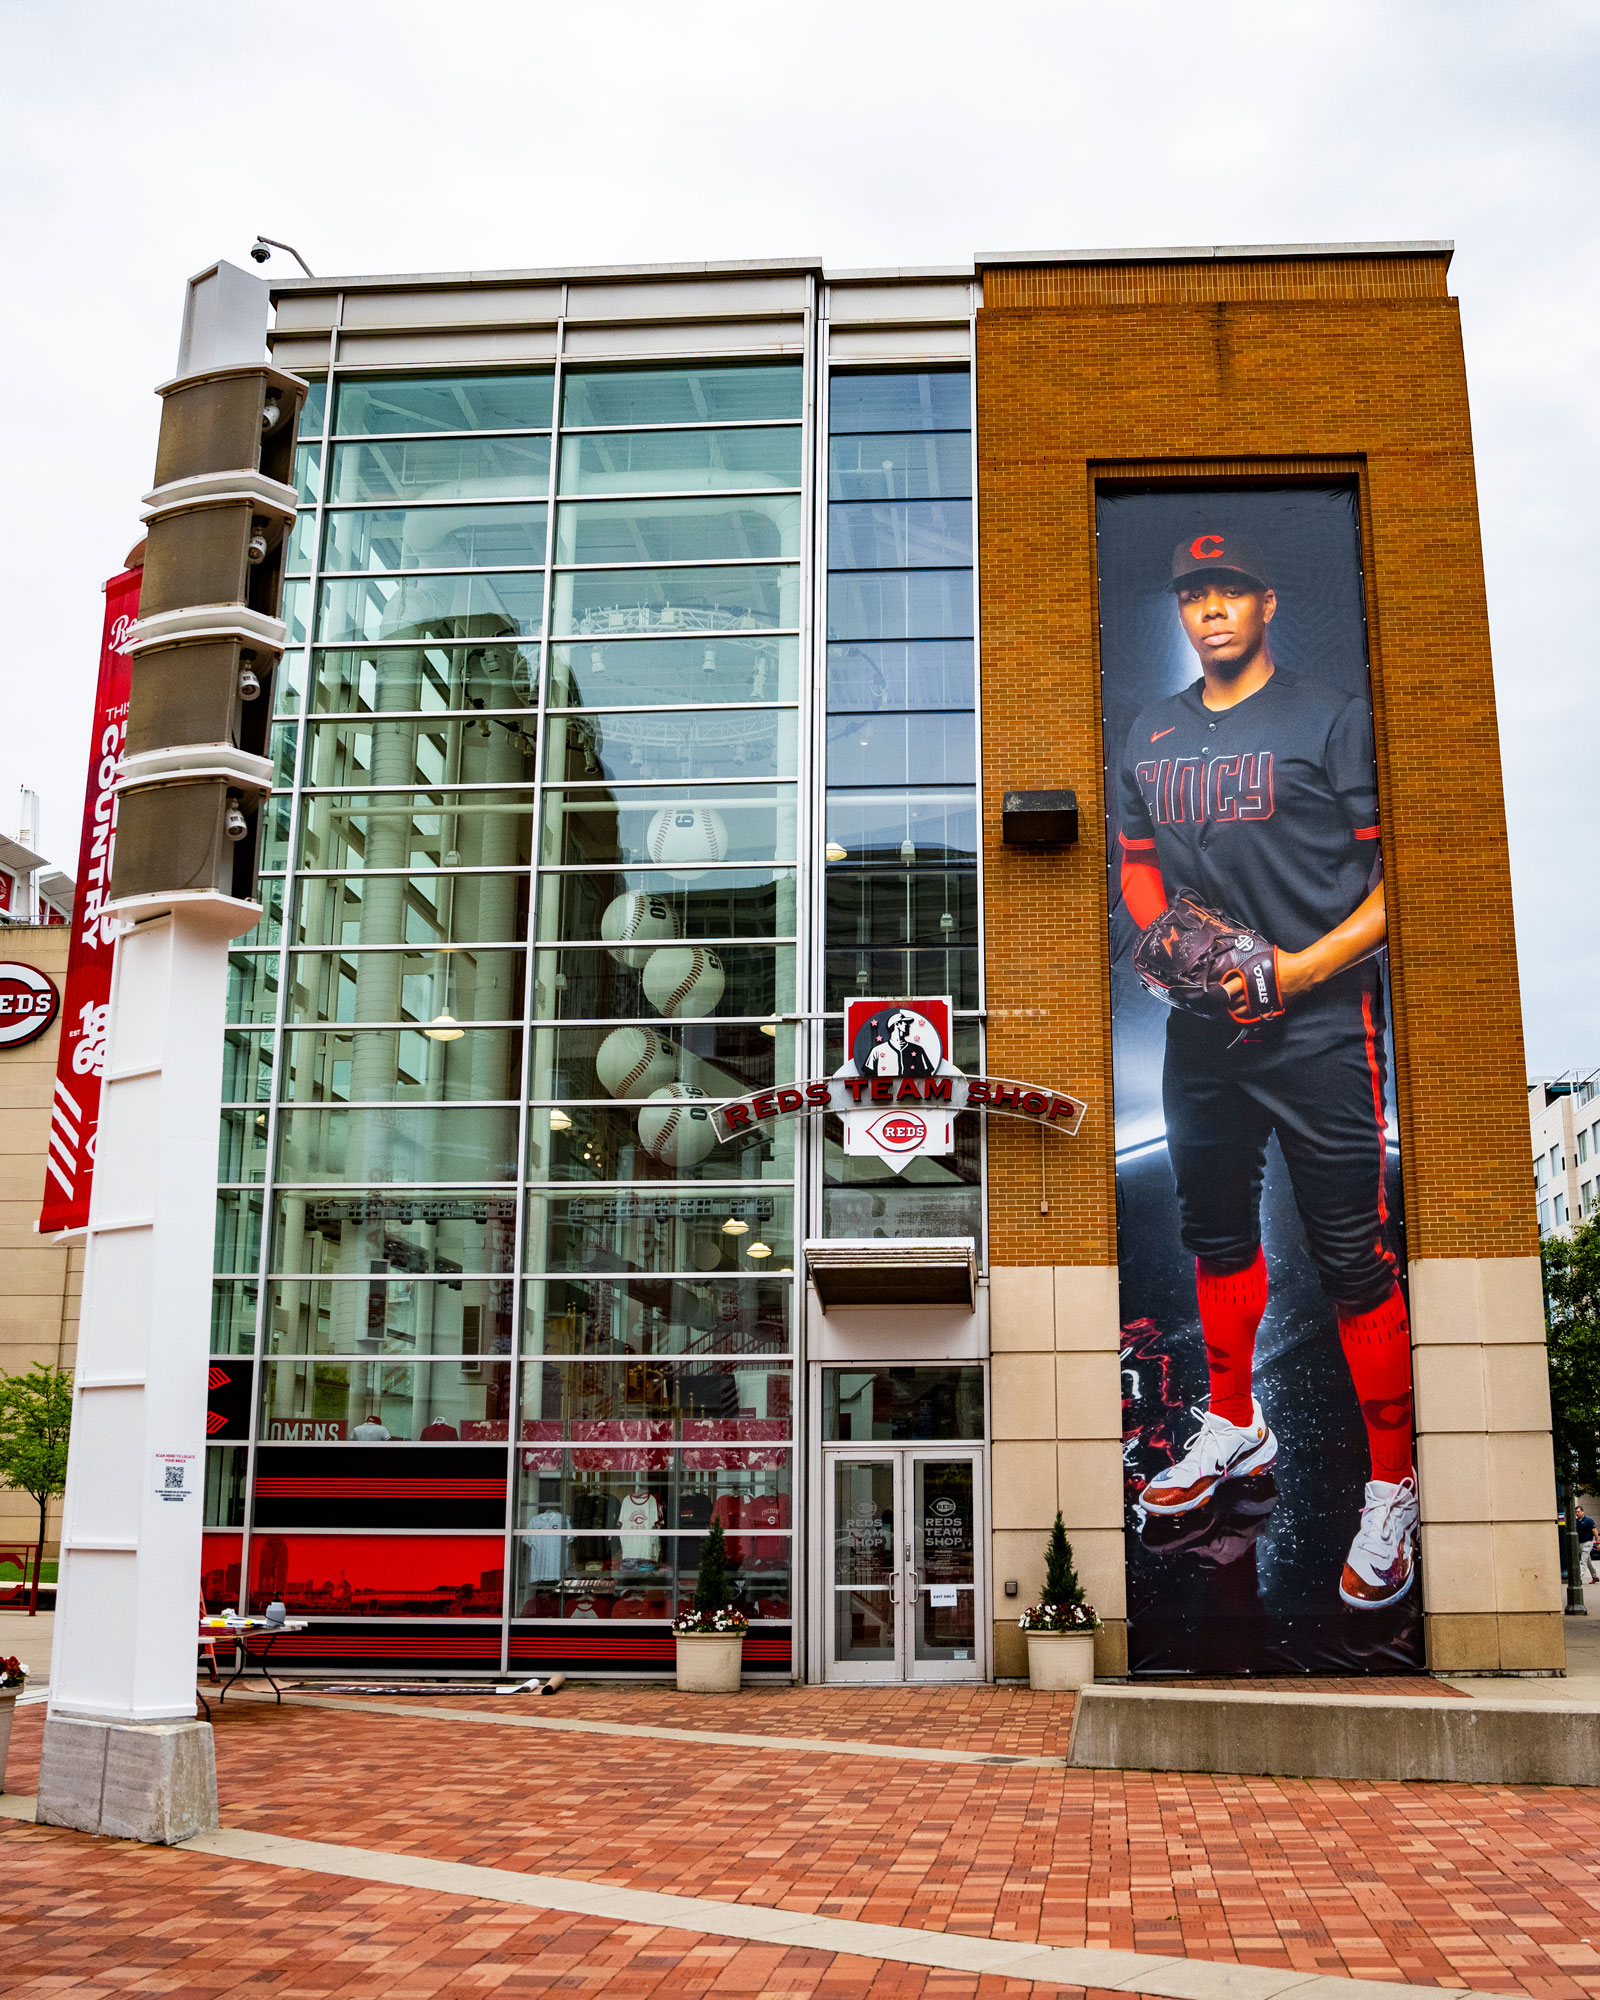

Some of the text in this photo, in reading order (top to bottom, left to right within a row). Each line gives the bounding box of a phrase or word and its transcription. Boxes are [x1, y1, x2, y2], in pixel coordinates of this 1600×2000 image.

[1135, 751, 1275, 824] CINCY
[81, 723, 119, 951] COUNTRY
[69, 1028, 81, 1038] EST
[723, 1076, 1075, 1131] REDS TEAM SHOP
[884, 1126, 925, 1138] REDS
[847, 1519, 883, 1528] REDS
[925, 1517, 963, 1527] REDS
[848, 1528, 883, 1537] TEAM
[925, 1527, 963, 1537] TEAM
[847, 1538, 883, 1547] SHOP
[925, 1537, 963, 1547] SHOP
